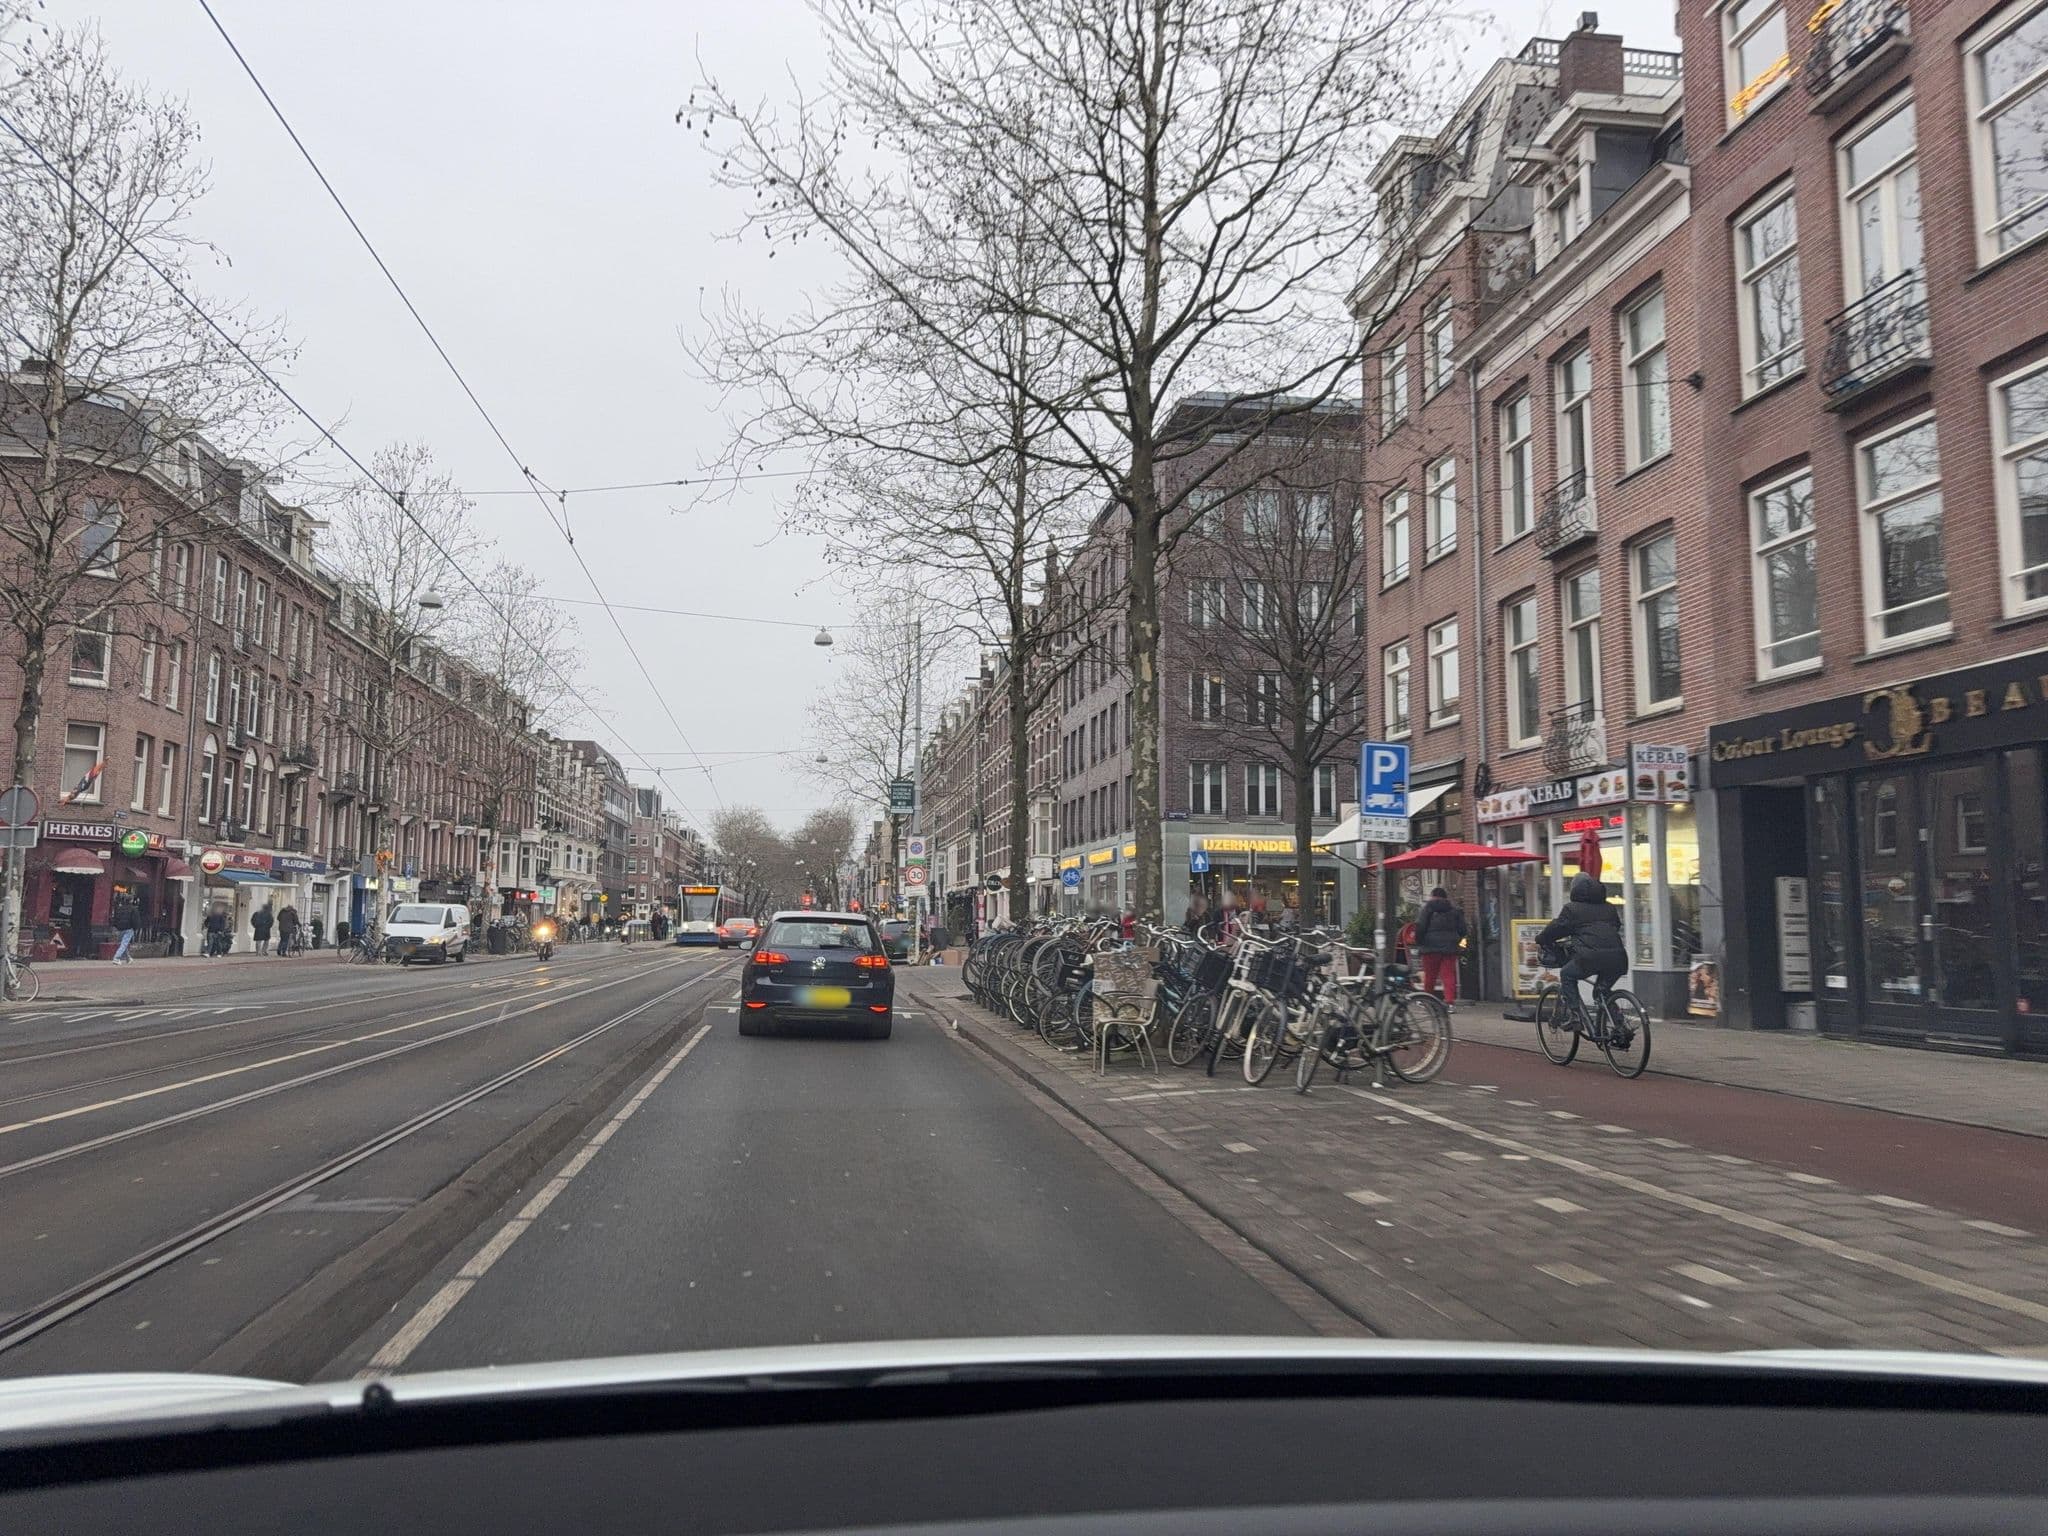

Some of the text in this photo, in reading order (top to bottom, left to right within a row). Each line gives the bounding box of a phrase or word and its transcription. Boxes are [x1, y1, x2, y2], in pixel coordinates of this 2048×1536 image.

[1712, 722, 1857, 762] Colour Lounge
[1635, 751, 1687, 764] KEBAB
[1372, 750, 1399, 785] P
[1526, 780, 1573, 805] KEBAB
[49, 823, 113, 838] HERMES
[1203, 839, 1294, 852] IJZERHANDEL
[911, 871, 923, 880] 30
